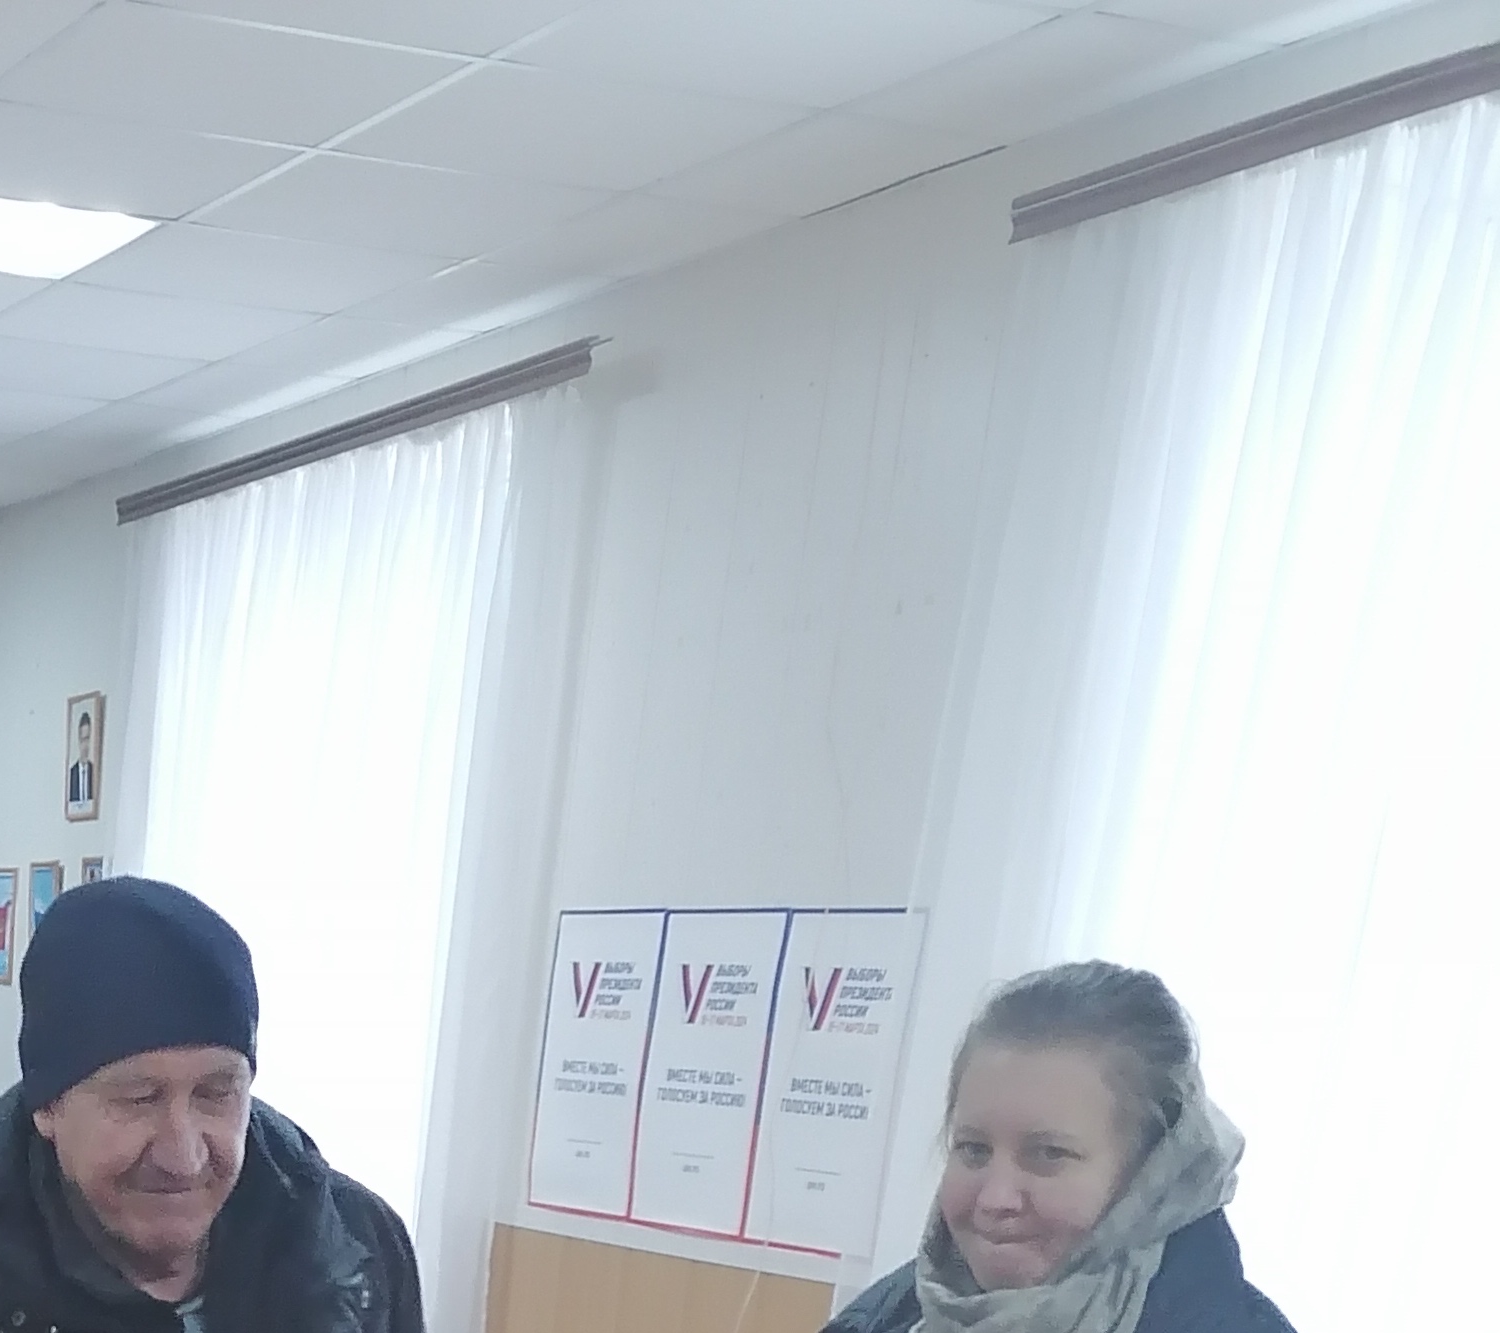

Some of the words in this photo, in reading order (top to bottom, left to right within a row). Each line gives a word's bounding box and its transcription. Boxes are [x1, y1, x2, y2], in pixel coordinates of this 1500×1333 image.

[790, 1077, 823, 1095] ВМЕСТЕ
[824, 1080, 840, 1096] МЫ
[841, 1082, 863, 1098] СИЛА
[780, 1098, 824, 1116] ГОЛОСУЕМ
[825, 1101, 836, 1117] ЗА
